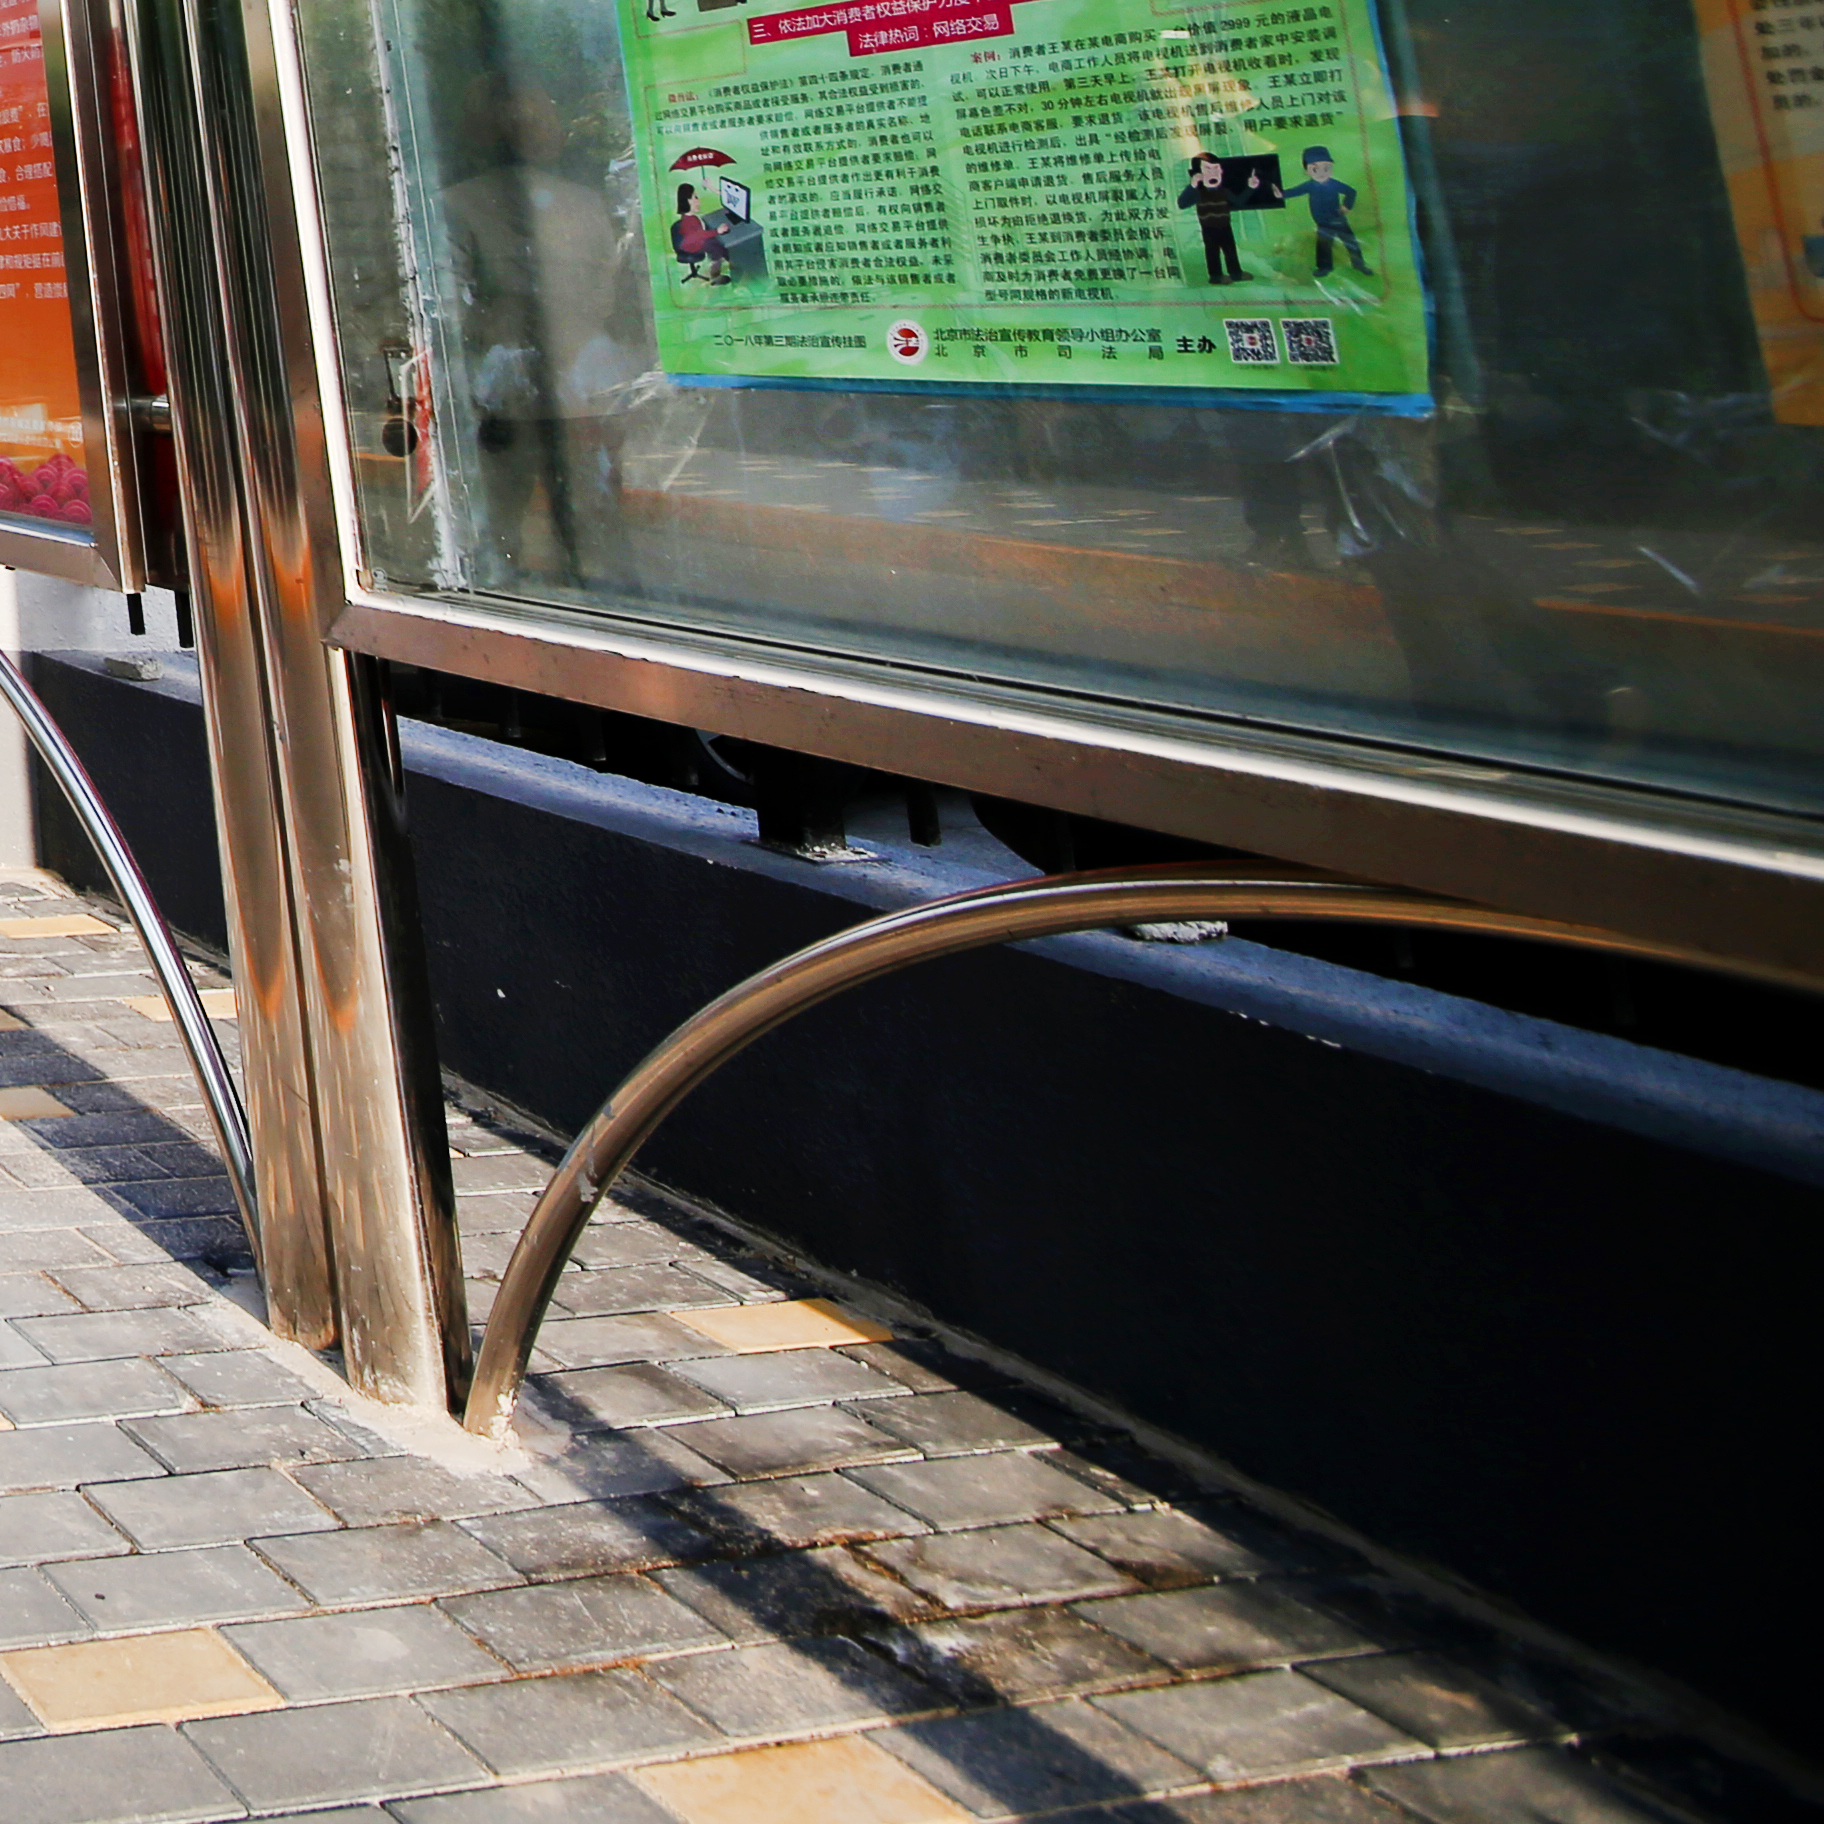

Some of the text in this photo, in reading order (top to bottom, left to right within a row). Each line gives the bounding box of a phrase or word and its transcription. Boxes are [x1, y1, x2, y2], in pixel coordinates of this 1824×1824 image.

[857, 12, 1000, 50] 法律热词：网络交易
[930, 326, 1163, 344] 北京市法治宣传教育领导小组办公室
[1174, 334, 1218, 356] 主办
